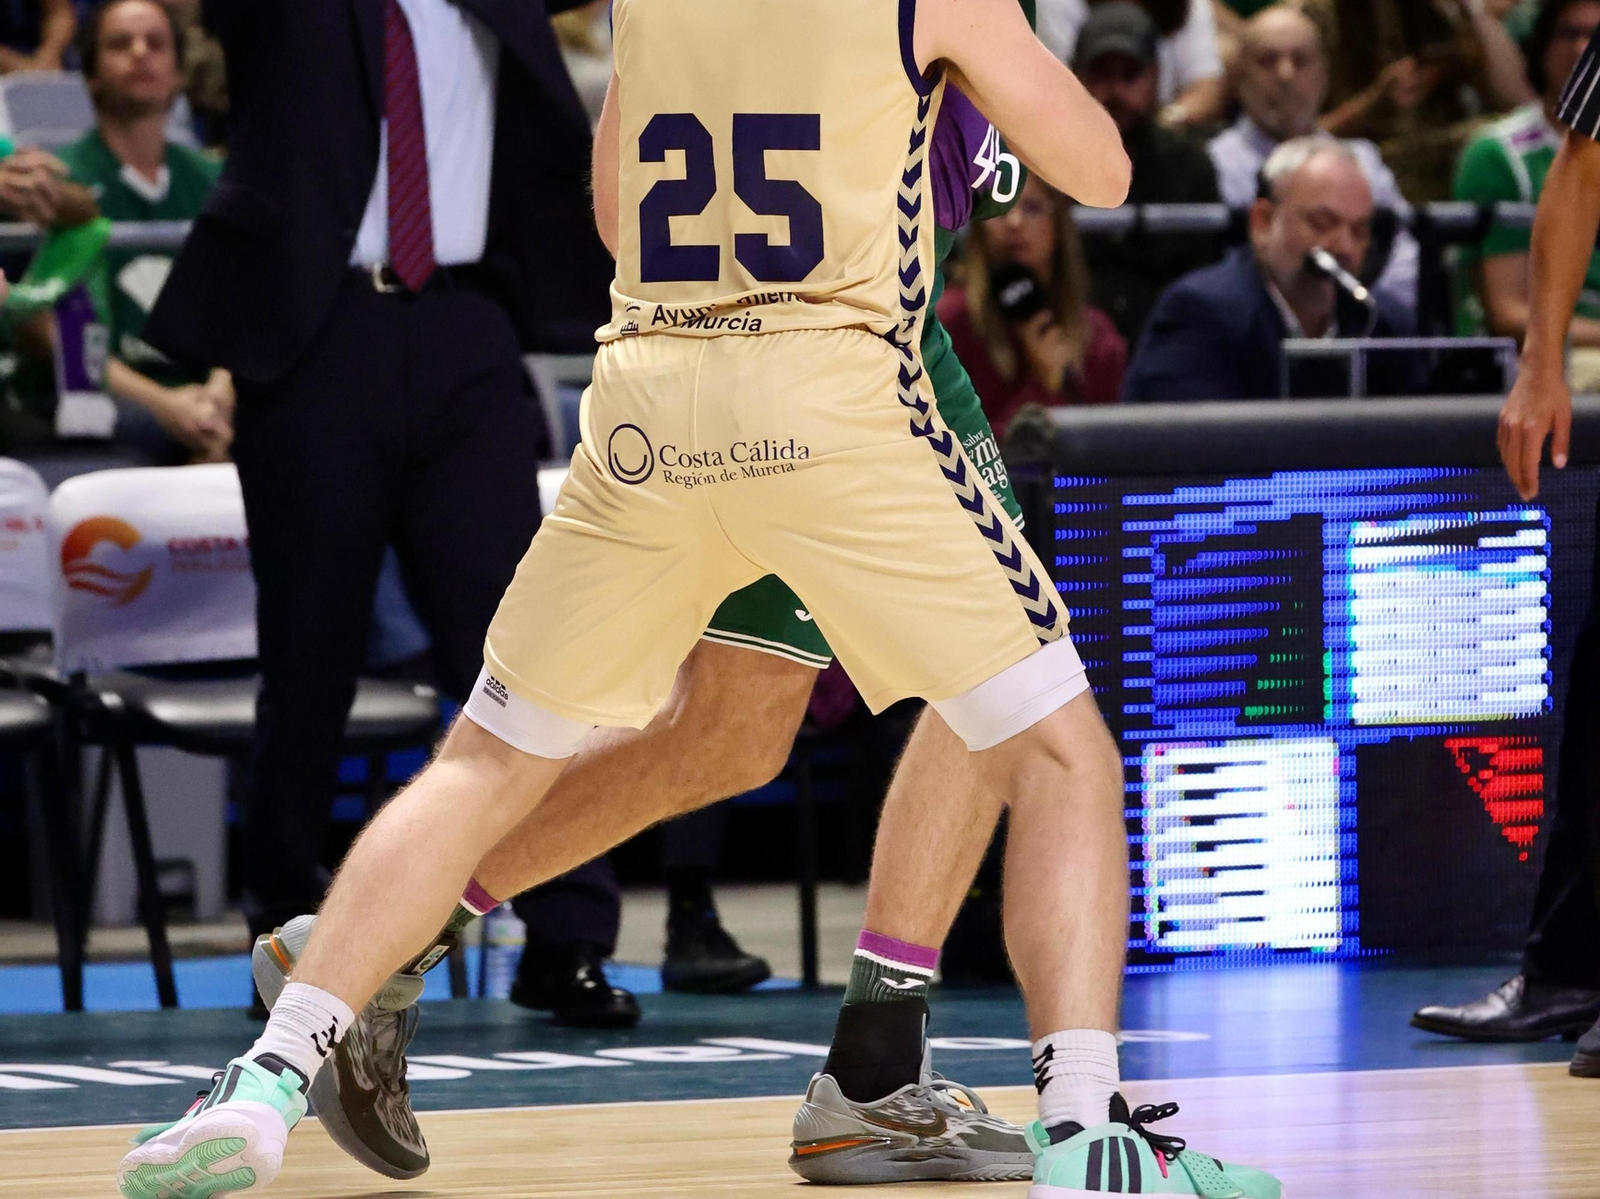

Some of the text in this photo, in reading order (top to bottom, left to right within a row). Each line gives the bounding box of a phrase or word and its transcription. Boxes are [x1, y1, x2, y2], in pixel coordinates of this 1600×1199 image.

[638, 113, 825, 283] 25
[658, 438, 810, 469] Costa Cálida
[662, 461, 796, 490] Región de Murcia
[485, 678, 509, 701] adidas
